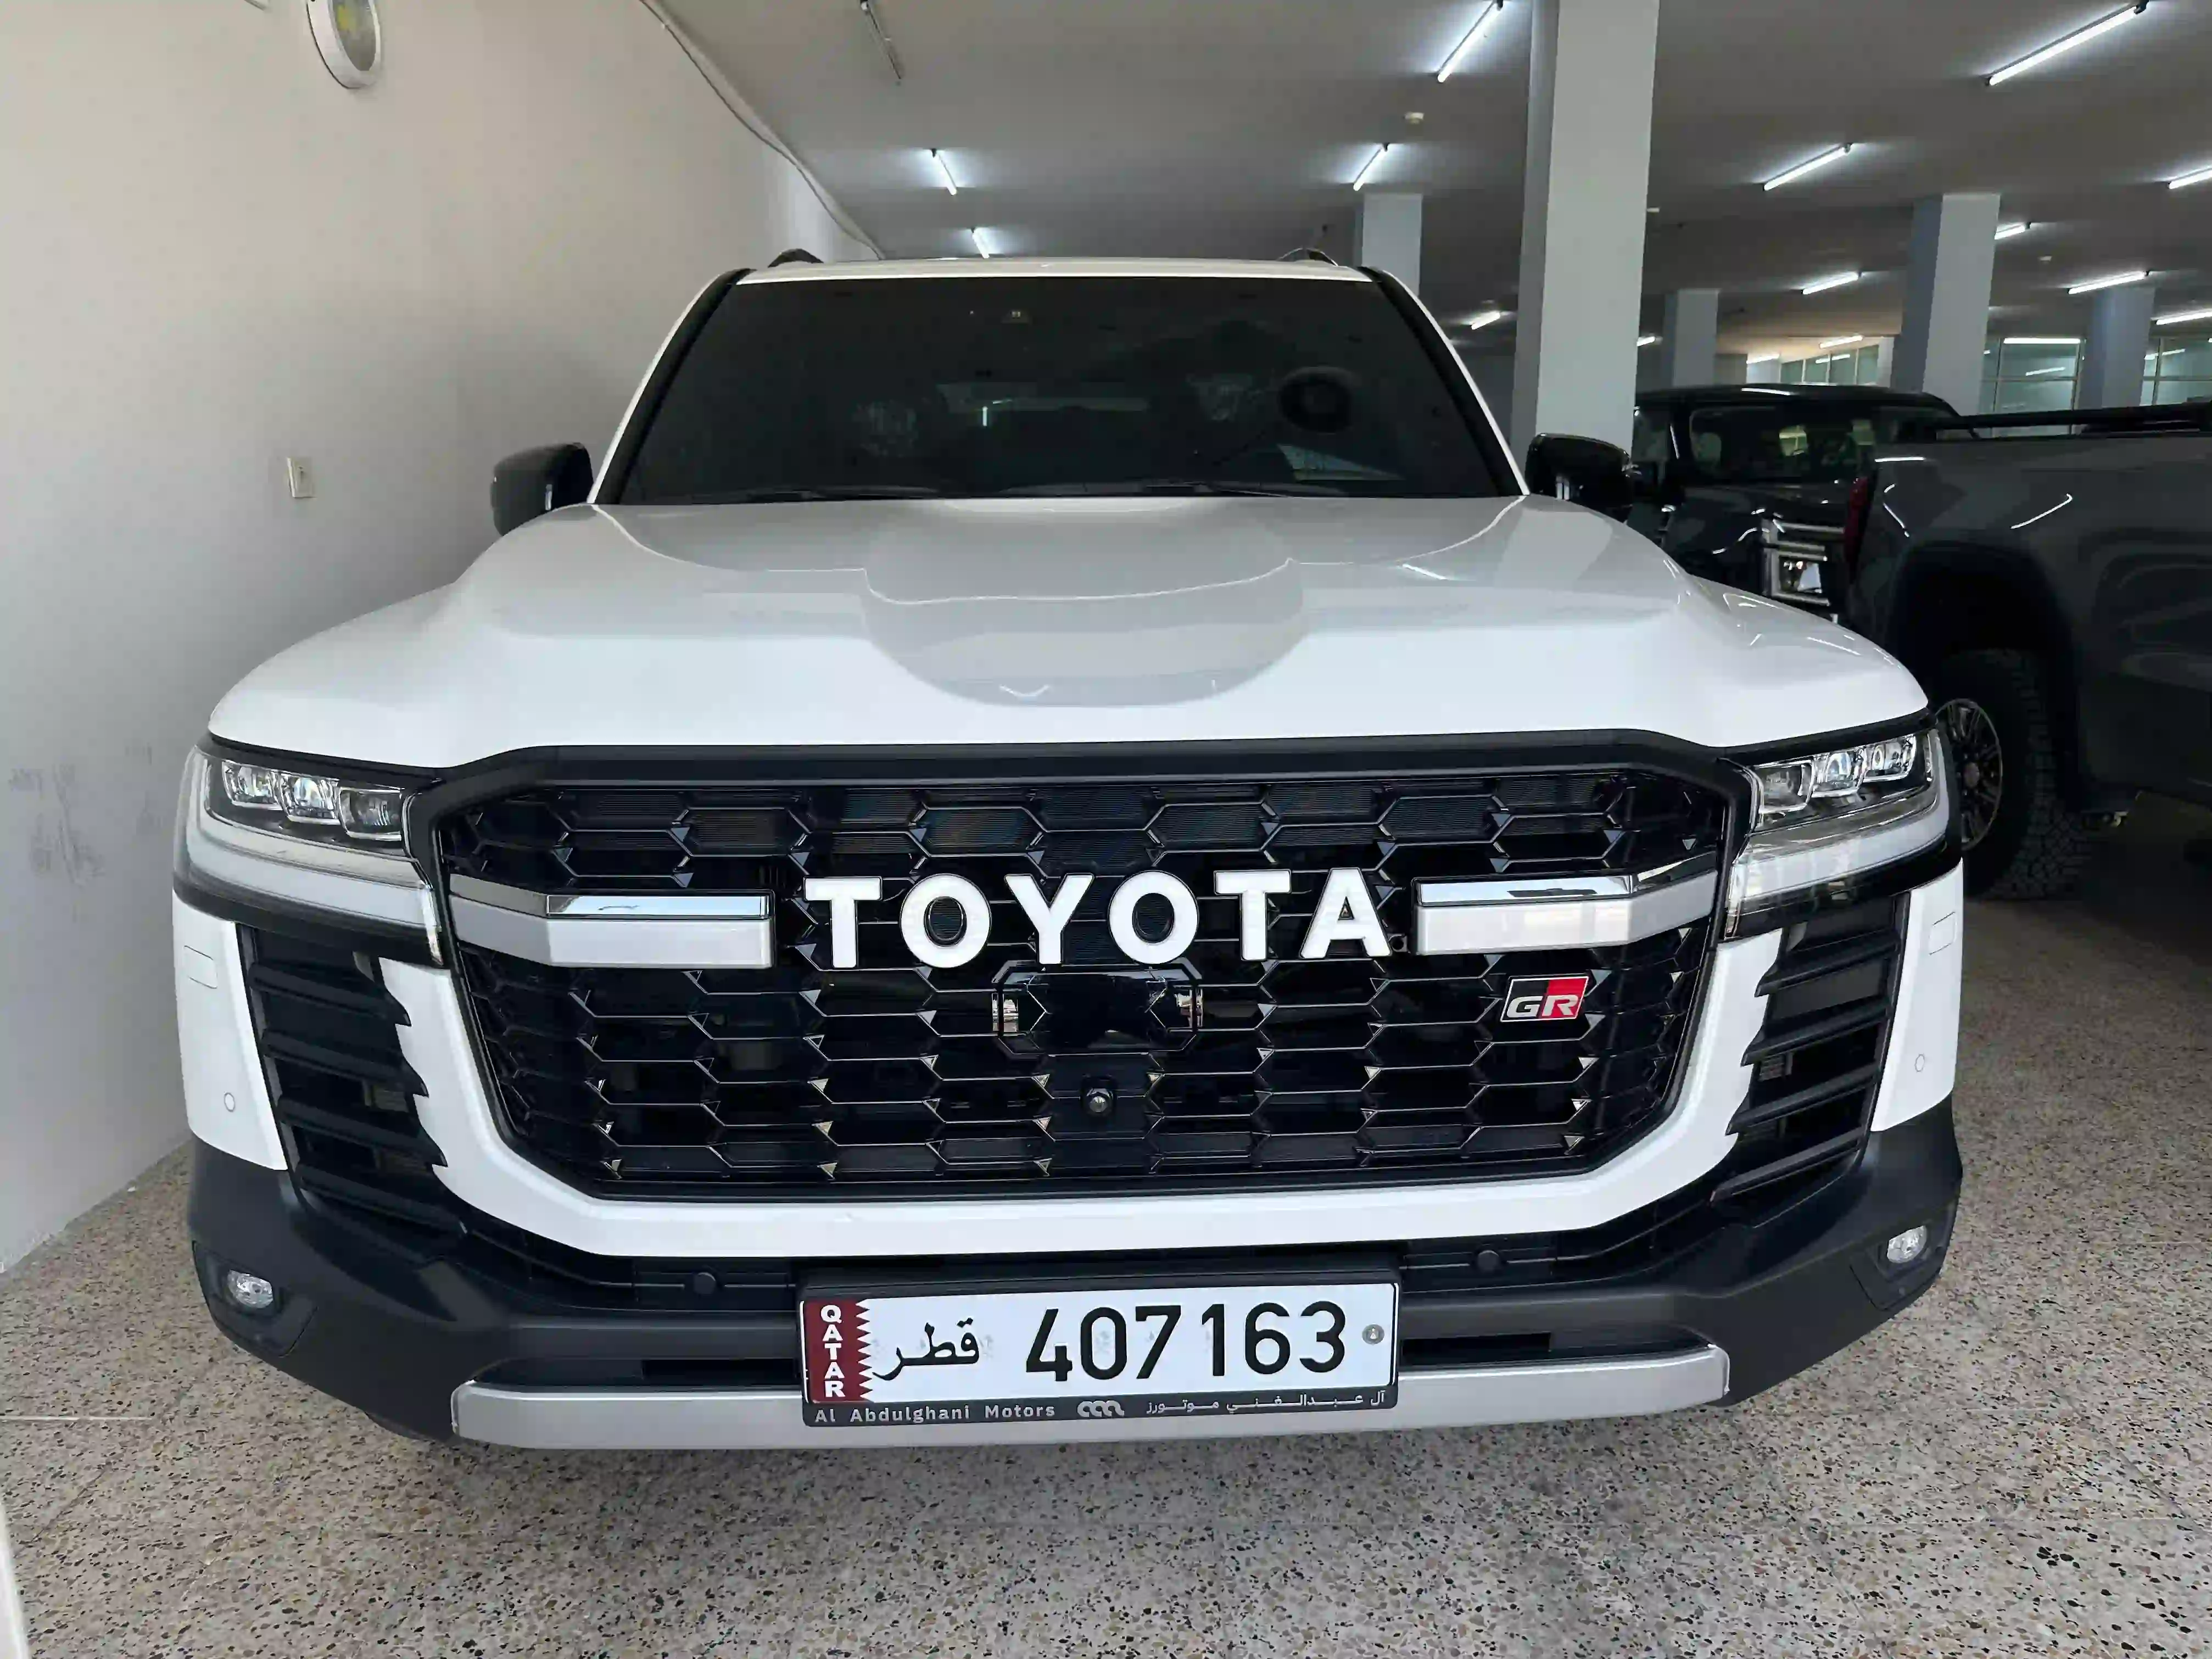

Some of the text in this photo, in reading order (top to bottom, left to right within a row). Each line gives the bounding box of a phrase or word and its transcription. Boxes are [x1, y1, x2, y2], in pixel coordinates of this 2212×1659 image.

[804, 867, 1393, 968] TOYOTA
[1506, 995, 1579, 1018] GR
[820, 1305, 846, 1398] QATAR
[872, 1317, 980, 1381] قطر
[1025, 1301, 1347, 1382] 407163
[814, 1405, 1055, 1423] Al Abdulghani Motors
[1146, 1399, 1220, 1415] موتورز
[1370, 1390, 1386, 1407] آل
